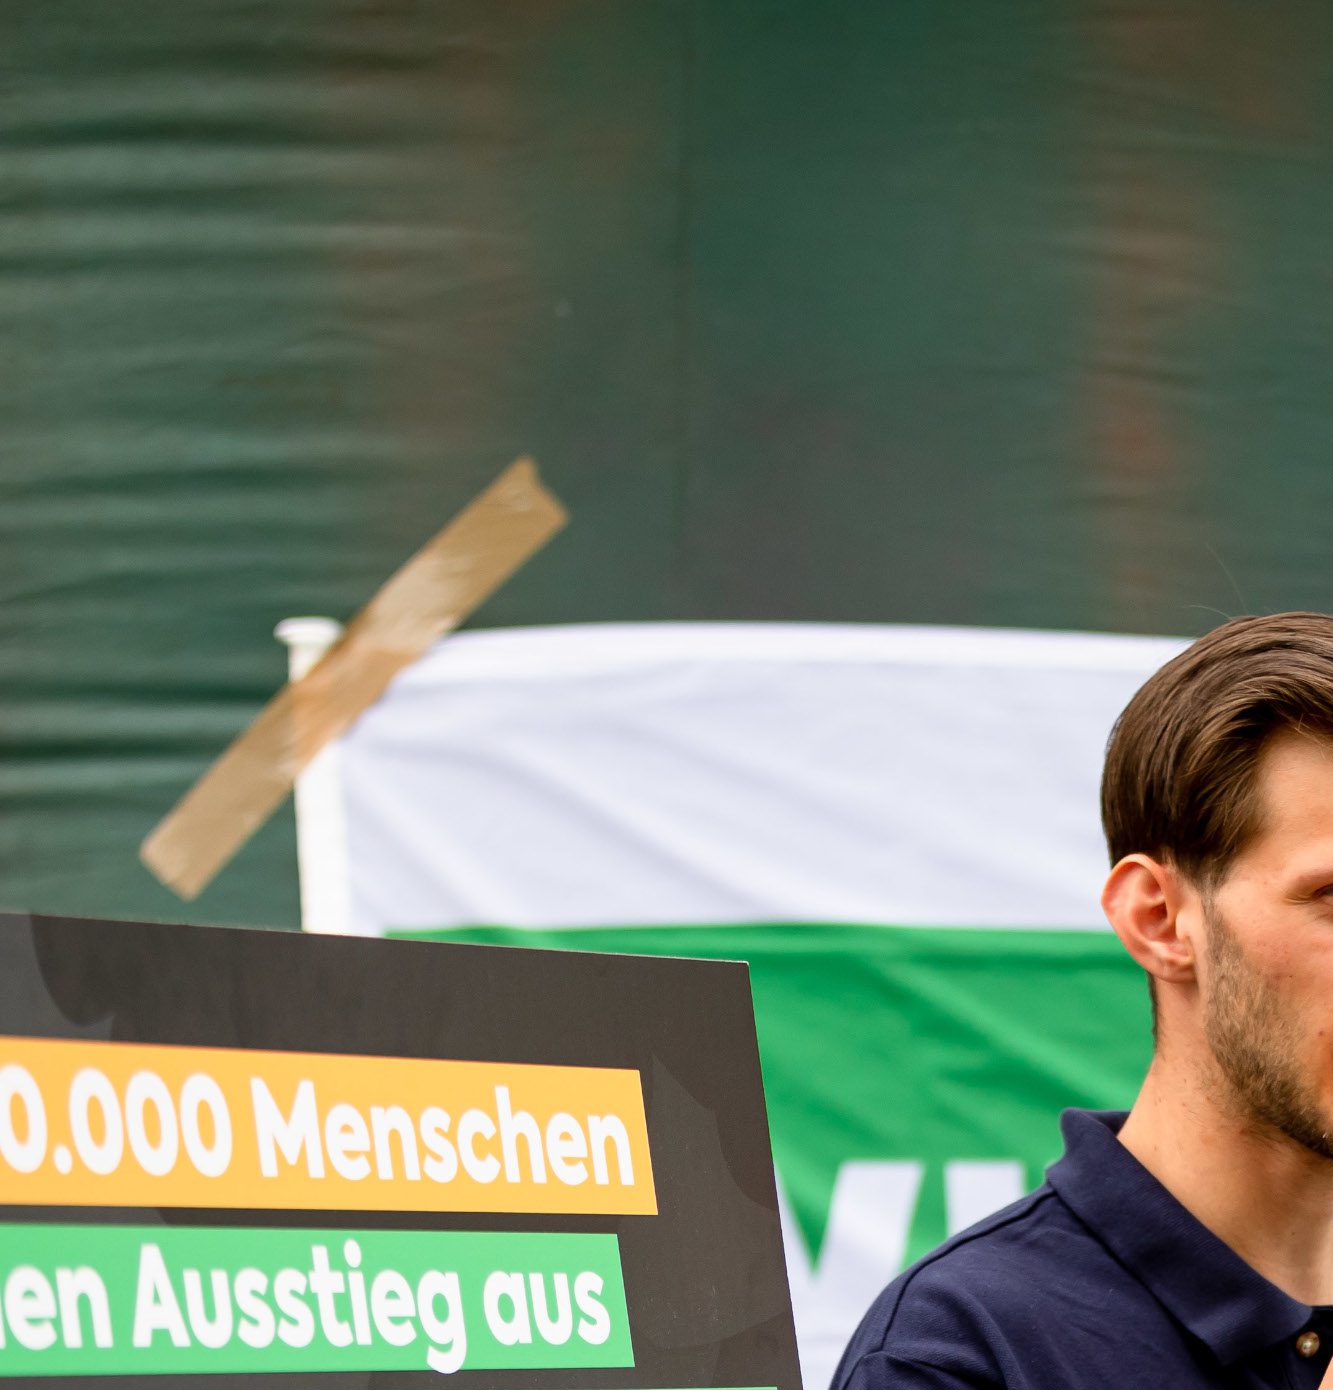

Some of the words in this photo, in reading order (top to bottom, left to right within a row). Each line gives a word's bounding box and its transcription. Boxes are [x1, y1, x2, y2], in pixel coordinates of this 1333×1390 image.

[250, 1076, 635, 1187] Menschen
[0, 1265, 114, 1350] en
[132, 1238, 468, 1375] Ausstieg
[482, 1270, 611, 1347] aus
